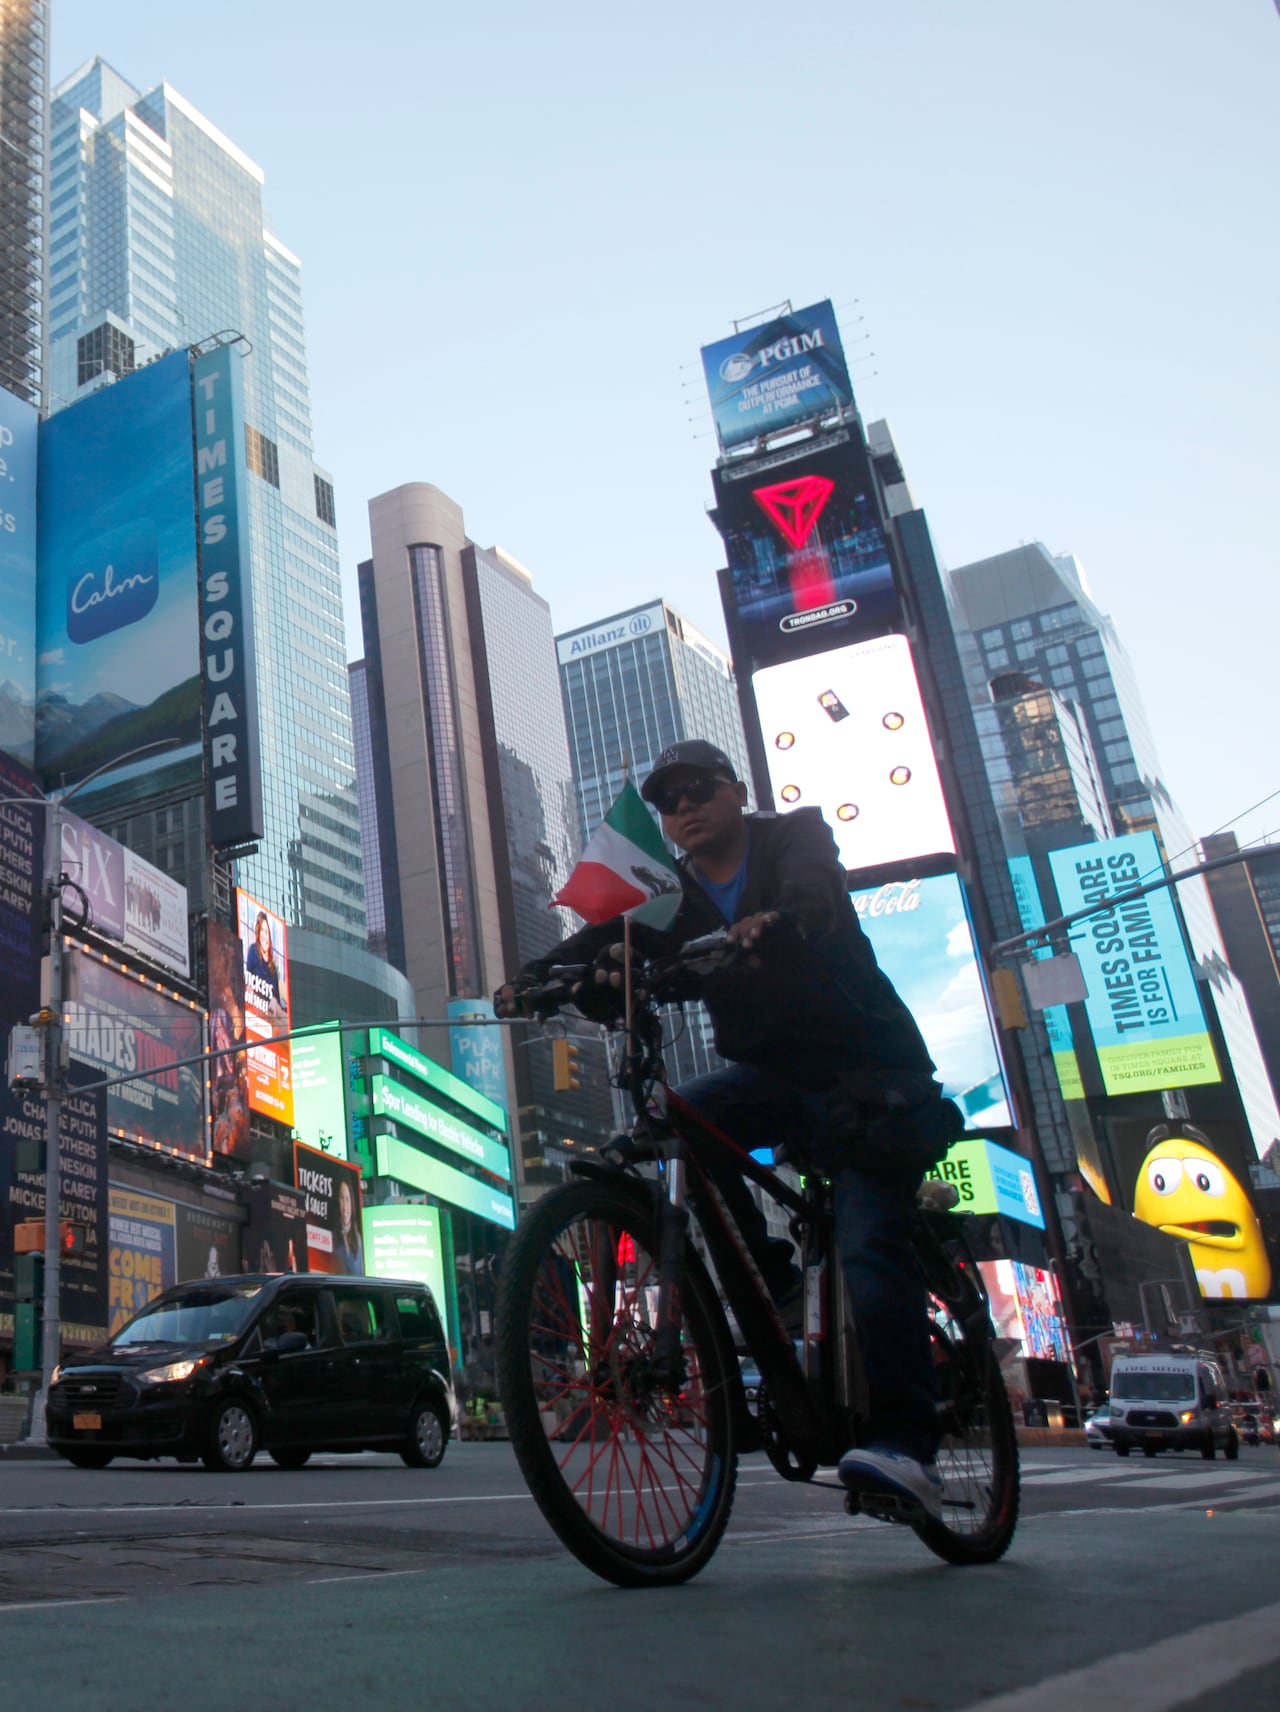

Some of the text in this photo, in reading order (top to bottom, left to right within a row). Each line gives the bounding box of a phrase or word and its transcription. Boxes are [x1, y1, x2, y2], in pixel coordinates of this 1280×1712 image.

[758, 328, 825, 367] PGIM
[738, 374, 822, 413] OUTPERFORMANCE
[742, 365, 812, 399] THE PURSUIT OF
[71, 565, 155, 616] Calm
[198, 370, 239, 812] TIMES SQUARE
[570, 626, 627, 655] Allianz
[3, 828, 33, 856] PUTH
[1075, 857, 1145, 1034] TIMES SQUARE
[1107, 852, 1169, 1026] IS FOR FAMILIES
[244, 966, 274, 1000] TICKETS
[1122, 1060, 1151, 1071] TIMES
[1151, 1056, 1188, 1067] SQUARE
[1149, 1047, 1182, 1058] FAMILY
[1111, 1062, 1206, 1081] TSQ.ORG/FAMILIES
[2, 1116, 42, 1142] JONAS
[70, 1118, 97, 1140] PUTH
[401, 1095, 428, 1131] Lending
[437, 1118, 461, 1148] Electric
[460, 1130, 485, 1159] Vehicles
[9, 1185, 47, 1211] MICKE
[63, 1178, 97, 1202] CAREY
[298, 1167, 333, 1198] TICKETS
[108, 1247, 163, 1285] COME
